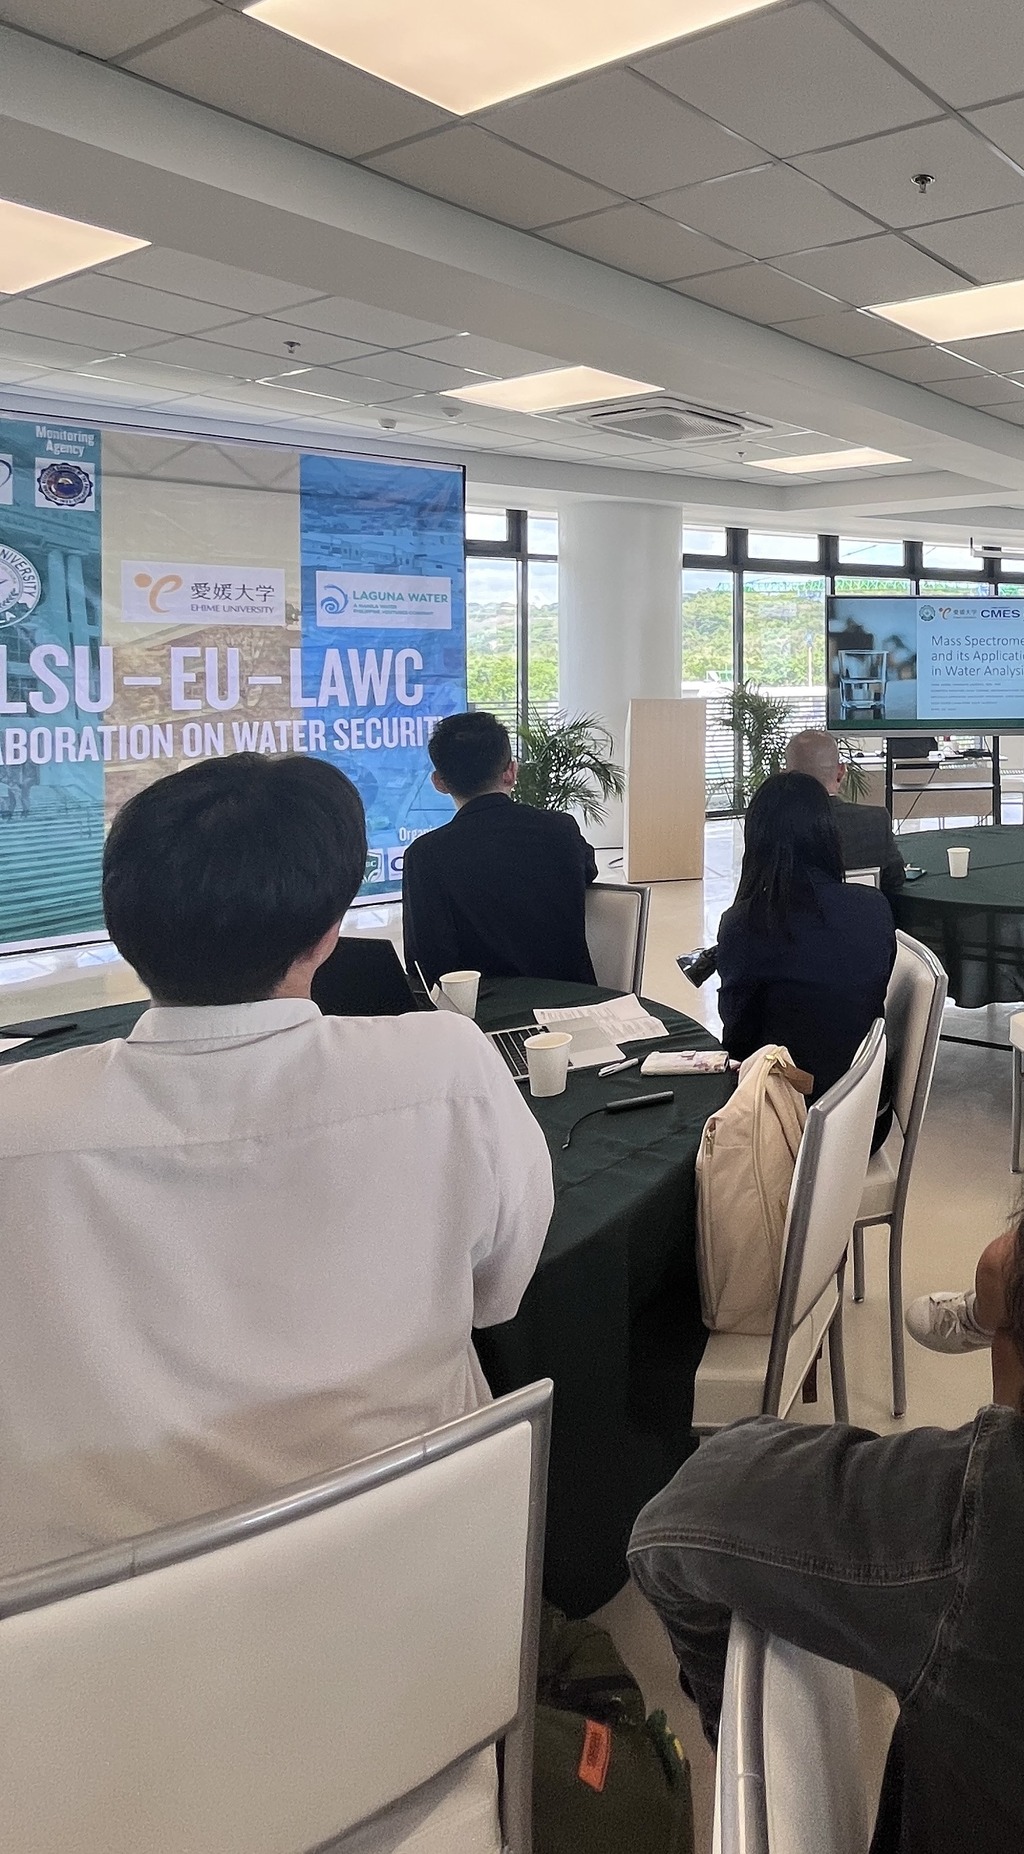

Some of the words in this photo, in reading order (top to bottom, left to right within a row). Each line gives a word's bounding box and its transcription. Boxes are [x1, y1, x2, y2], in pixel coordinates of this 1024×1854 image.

[35, 425, 95, 447] Monitoring
[45, 440, 85, 457] Agency
[190, 582, 276, 602] 愛媛大学
[352, 590, 405, 602] LAGUNA
[408, 593, 448, 603] WATER
[190, 603, 221, 613] EHIME
[222, 604, 275, 614] UNIVERSITY
[980, 609, 1021, 618] CMES
[931, 635, 962, 646] Mass
[931, 650, 953, 661] and
[956, 650, 970, 661] its
[931, 665, 942, 676] in
[945, 665, 981, 676] Water
[0, 723, 174, 766] BORATION
[182, 722, 224, 758] ON
[232, 718, 327, 754] WATER
[333, 715, 443, 751] SECURIT
